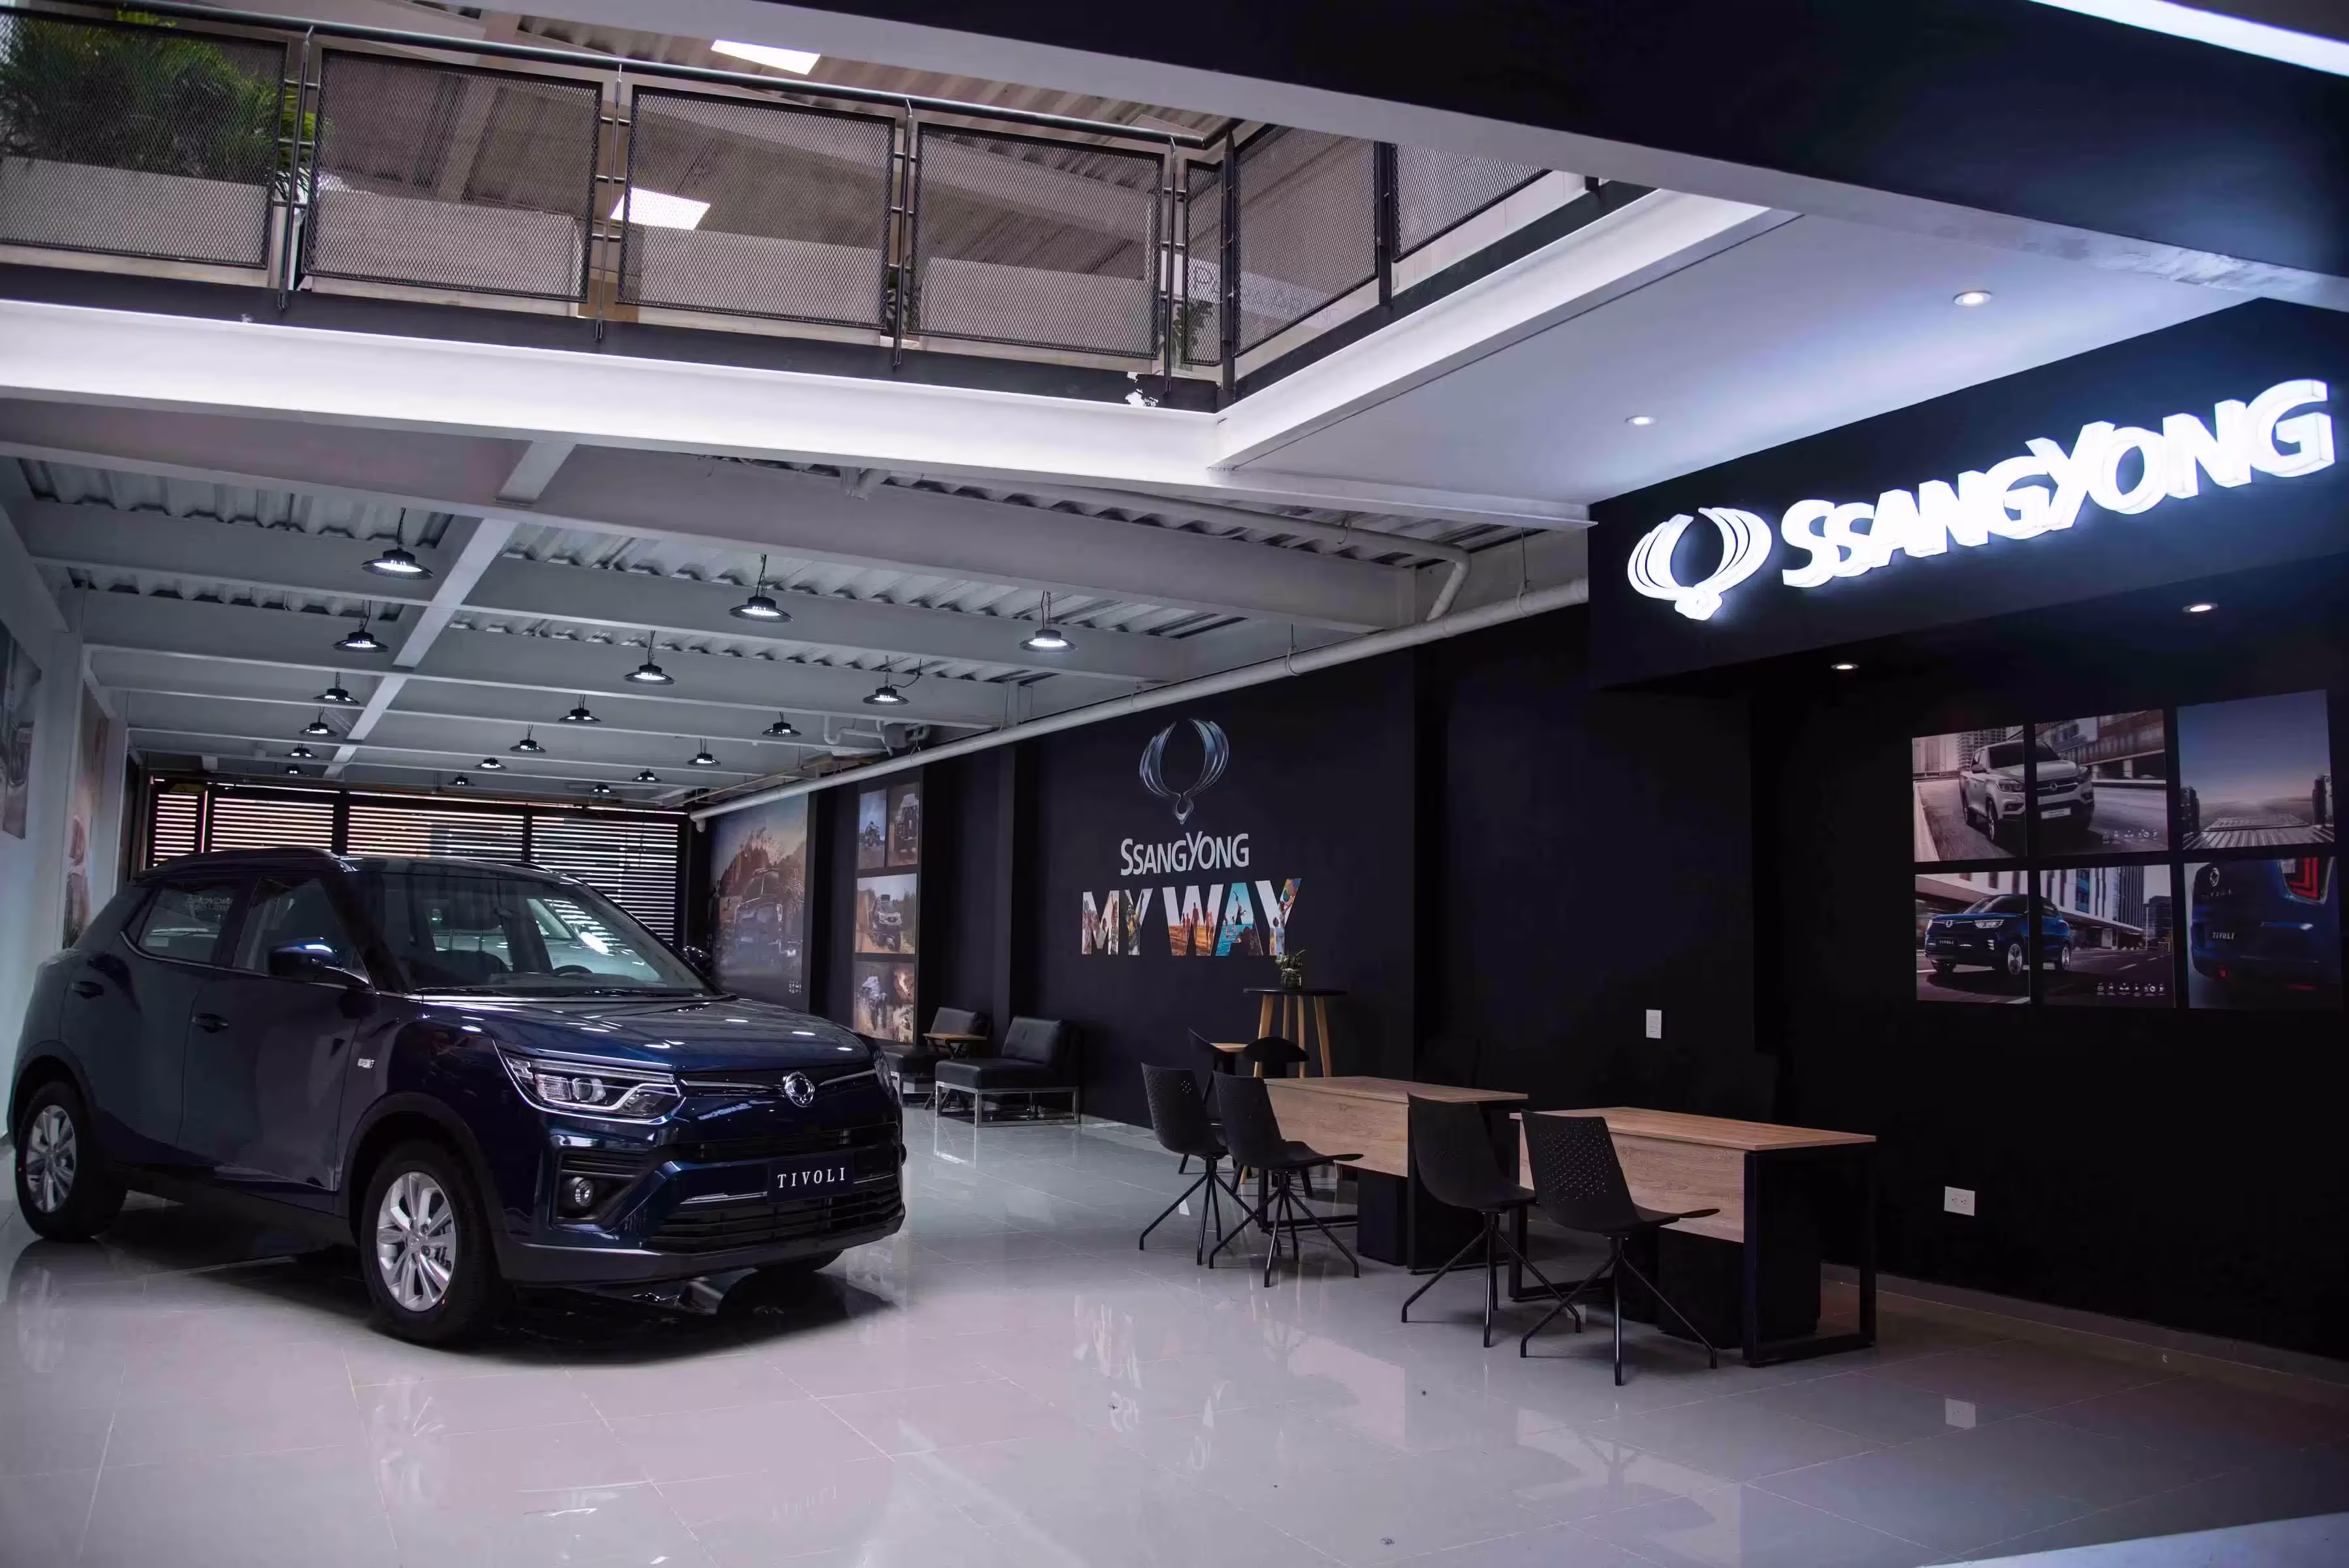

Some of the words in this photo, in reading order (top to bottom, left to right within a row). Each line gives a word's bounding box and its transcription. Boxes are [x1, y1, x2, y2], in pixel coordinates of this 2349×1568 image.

[1782, 379, 2335, 588] SSANGYONG
[1121, 831, 1250, 875] SSANGYONG
[1082, 888, 1153, 955] MY
[1163, 878, 1302, 956] WAY
[777, 1167, 845, 1188] TIVOLI
